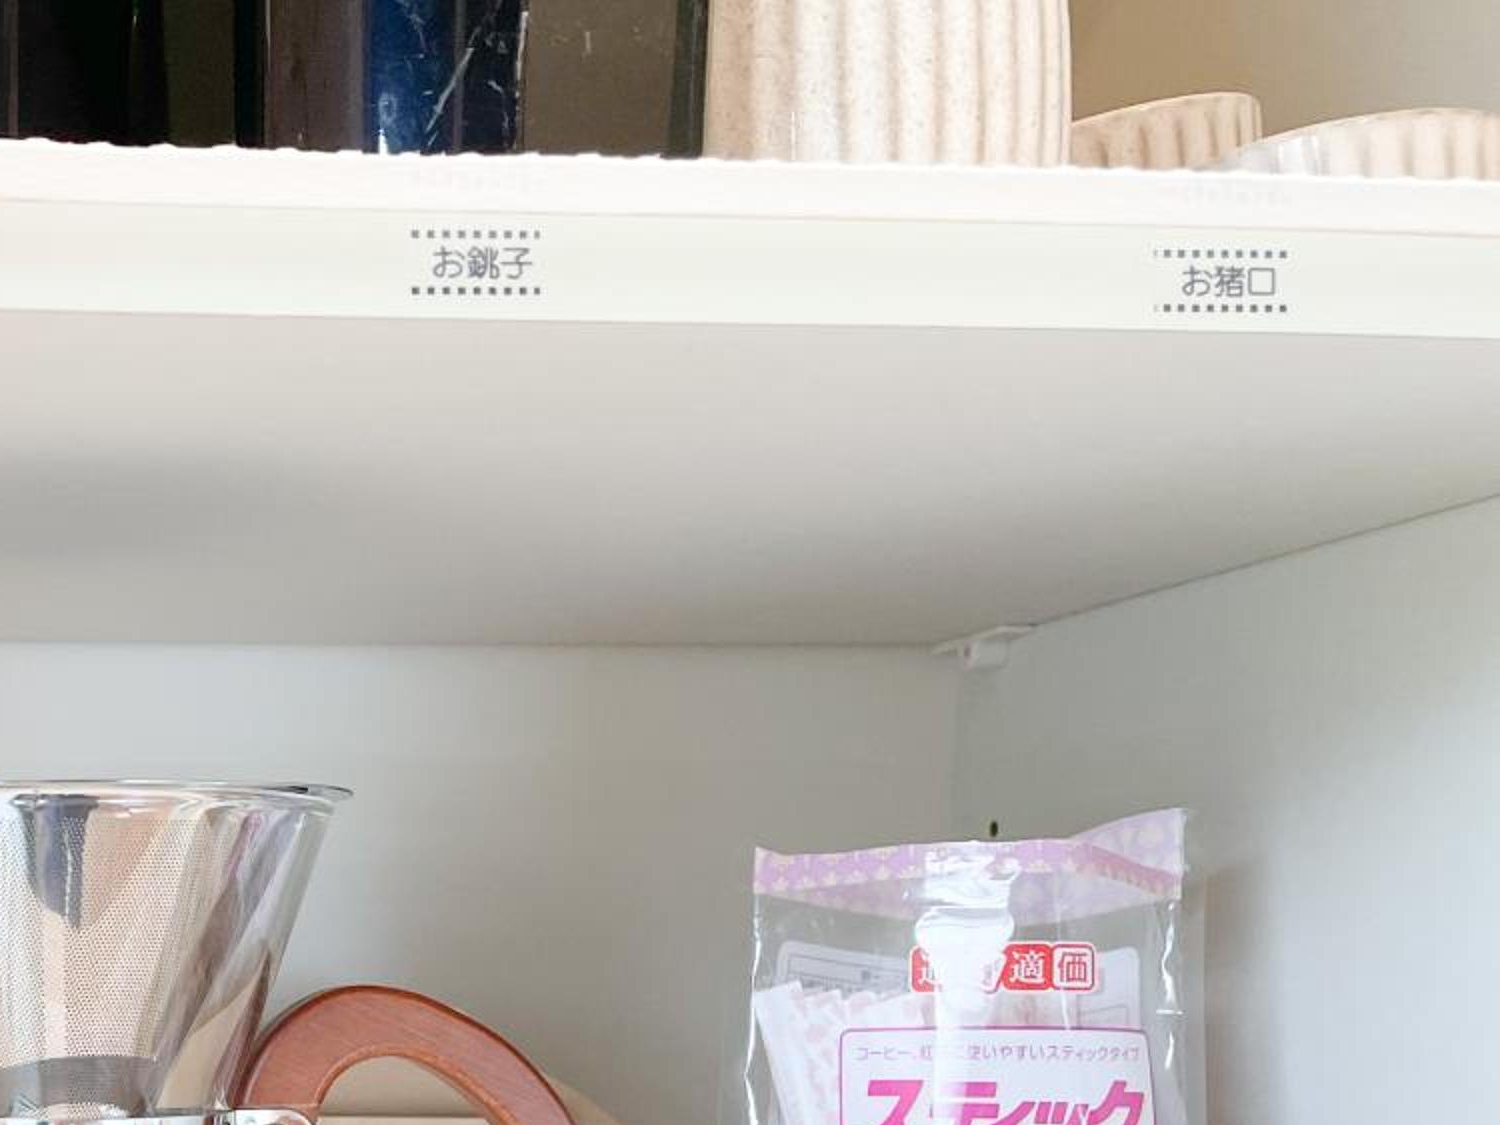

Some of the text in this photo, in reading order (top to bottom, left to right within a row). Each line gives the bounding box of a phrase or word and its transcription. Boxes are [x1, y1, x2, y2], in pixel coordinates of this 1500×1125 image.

[432, 246, 533, 280] お銚子
[1182, 265, 1276, 298] お猪口
